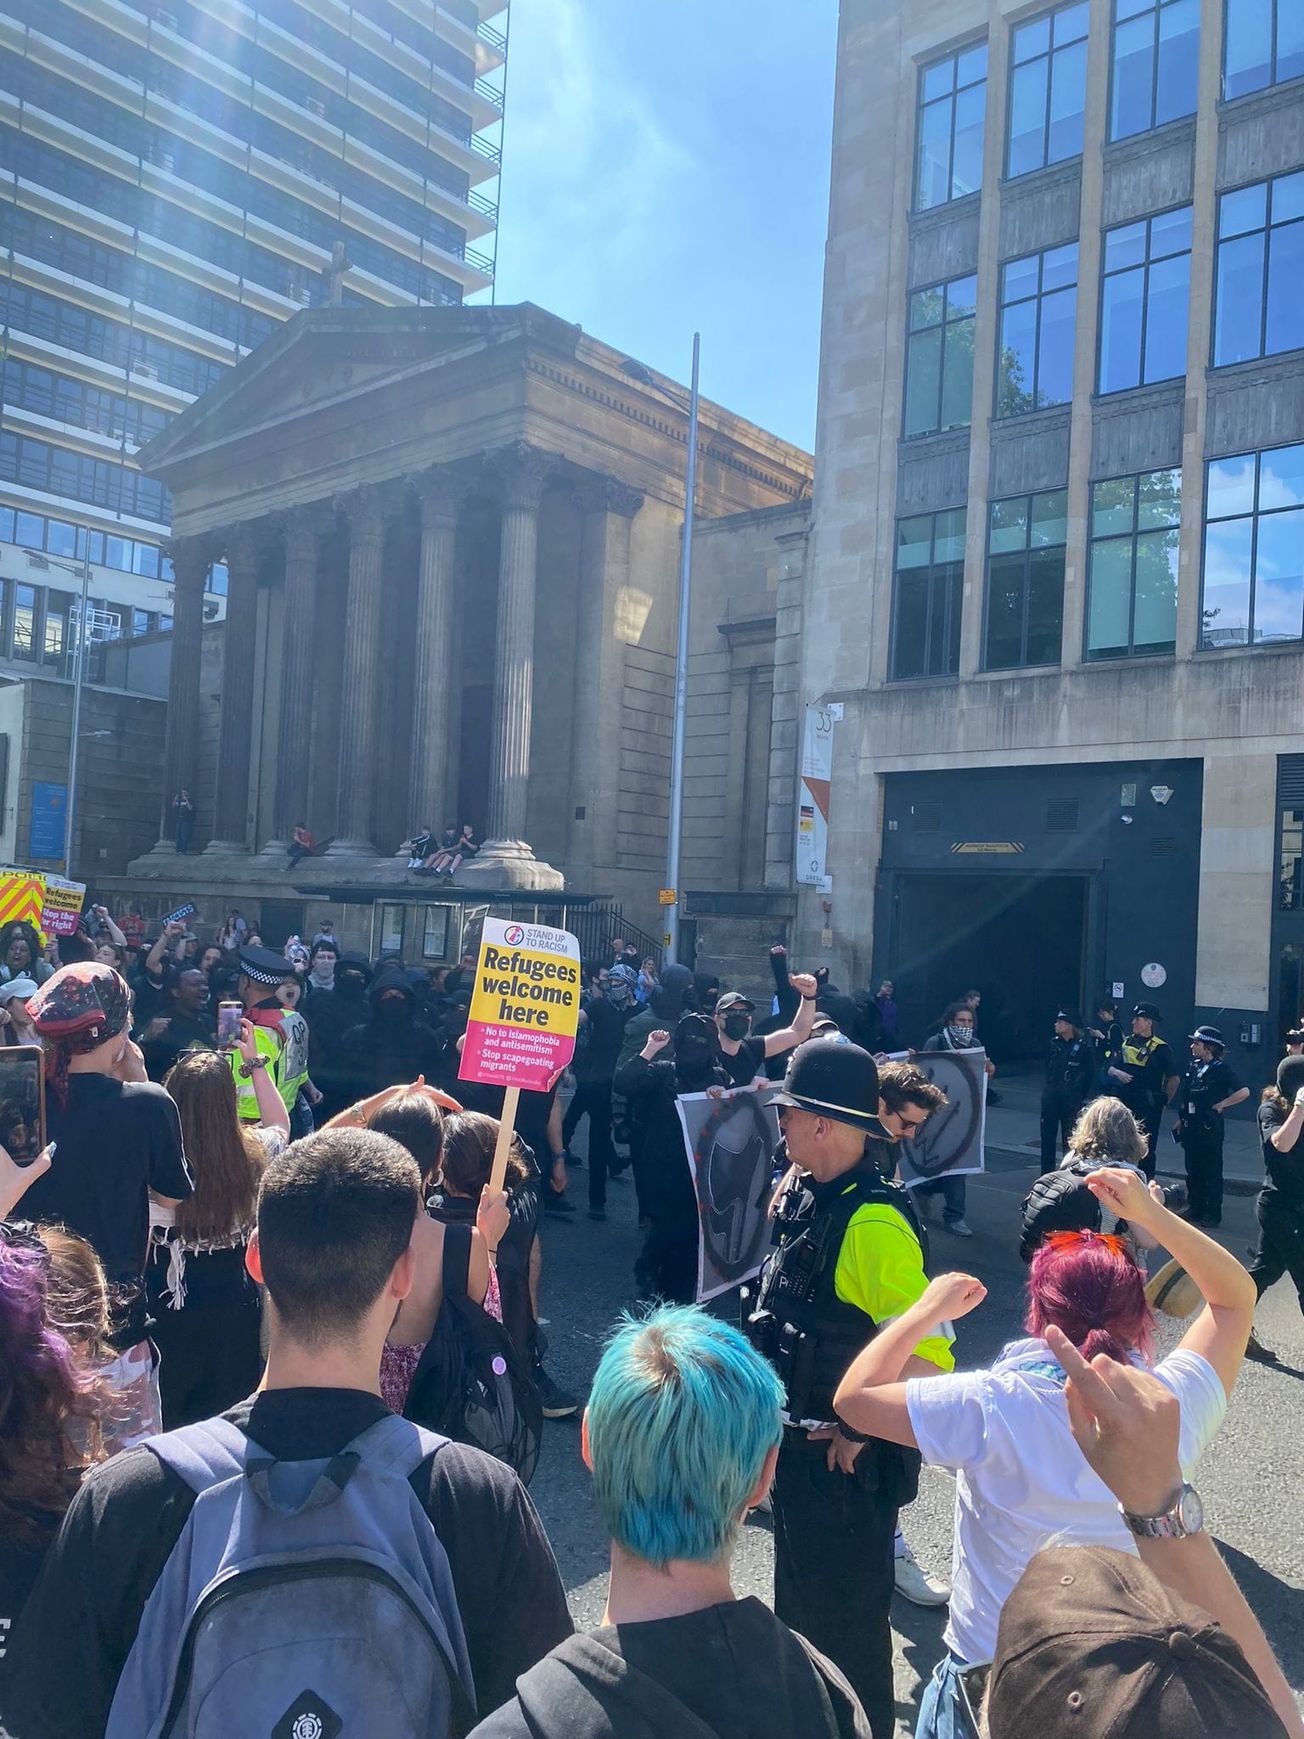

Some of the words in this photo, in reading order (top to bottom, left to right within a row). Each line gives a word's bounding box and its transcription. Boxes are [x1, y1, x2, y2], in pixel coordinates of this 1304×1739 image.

[816, 711, 832, 733] 33
[2, 871, 47, 881] POLI
[46, 887, 82, 901] Refugees
[45, 898, 78, 909] welcome
[43, 908, 59, 920] Stop
[61, 911, 75, 921] the
[42, 917, 50, 926] ar
[52, 919, 73, 930] right
[527, 928, 554, 941] STAND
[555, 933, 566, 943] UP
[526, 937, 537, 947] TO
[538, 940, 568, 953] RACISM
[484, 947, 576, 983] Refugees
[483, 976, 573, 1006] welcome
[499, 998, 549, 1026] here
[485, 1026, 497, 1036] No
[499, 1028, 507, 1037] to
[508, 1029, 560, 1046] Islamophobia
[484, 1037, 500, 1047] and
[500, 1040, 553, 1055] antisemitism
[480, 1060, 516, 1072] migrants
[482, 1048, 501, 1061] Stop
[502, 1053, 555, 1070] scapegoating
